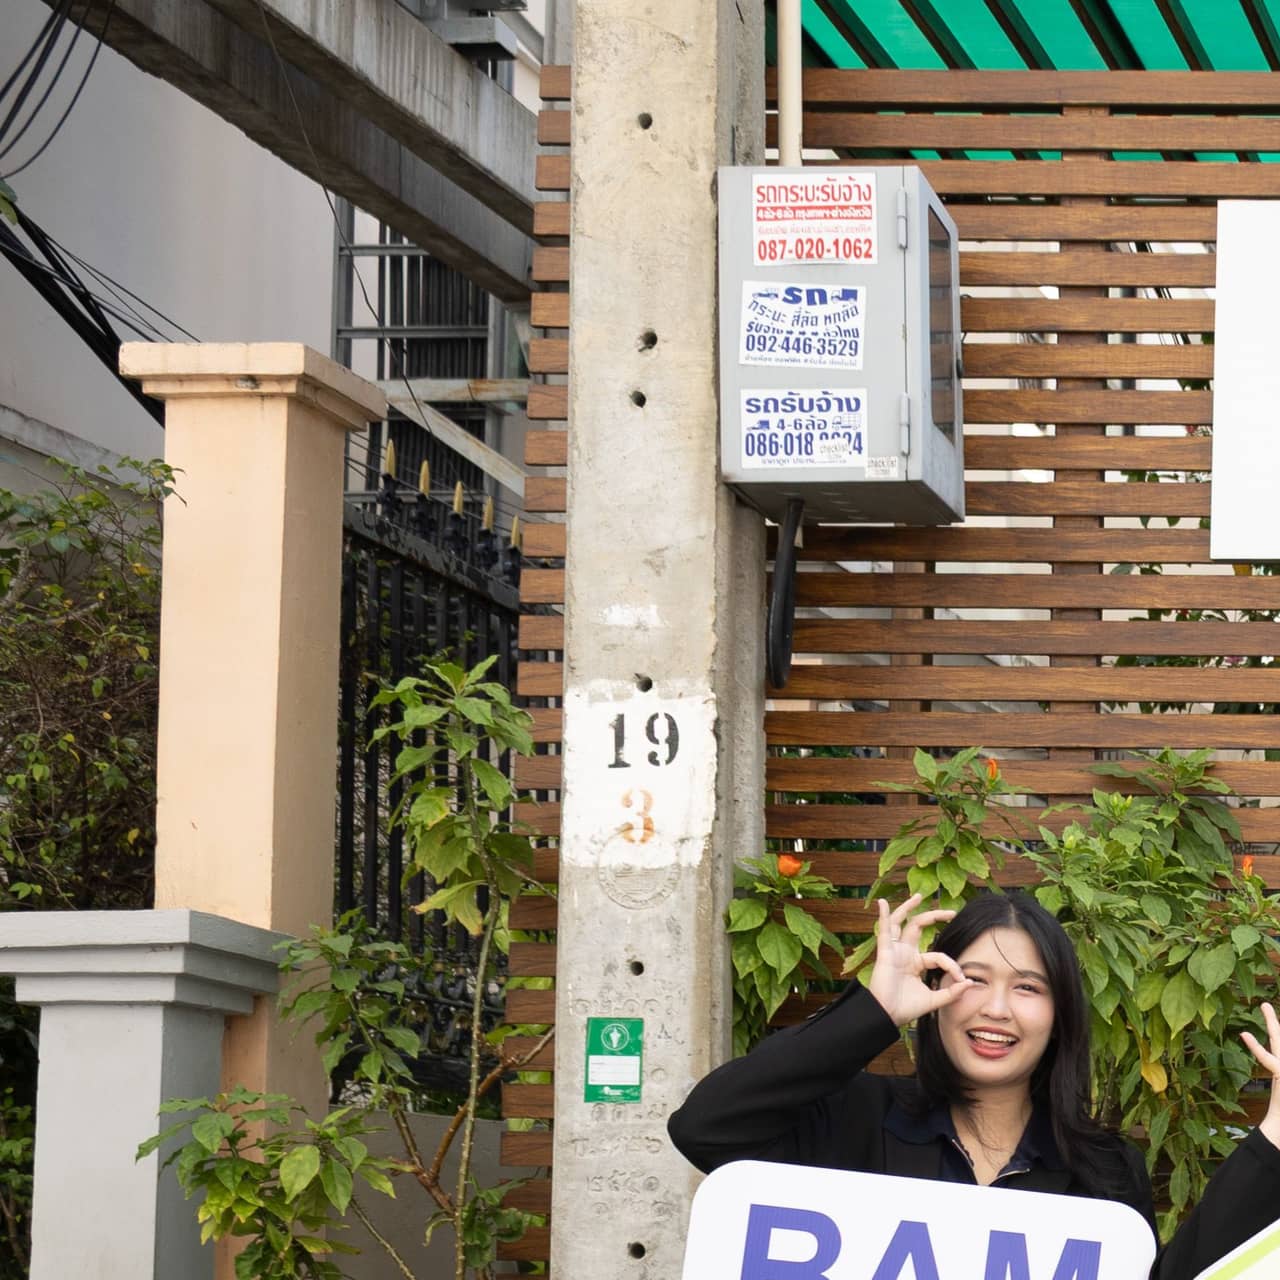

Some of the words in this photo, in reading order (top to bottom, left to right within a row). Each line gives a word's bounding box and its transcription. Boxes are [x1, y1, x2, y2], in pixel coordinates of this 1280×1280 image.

[756, 176, 872, 203] รถกระบะรับจ้าง
[757, 238, 873, 261] 087-020-1062
[745, 390, 862, 414] รถรับจ้าง
[607, 711, 680, 769] 19
[620, 788, 655, 845] 3
